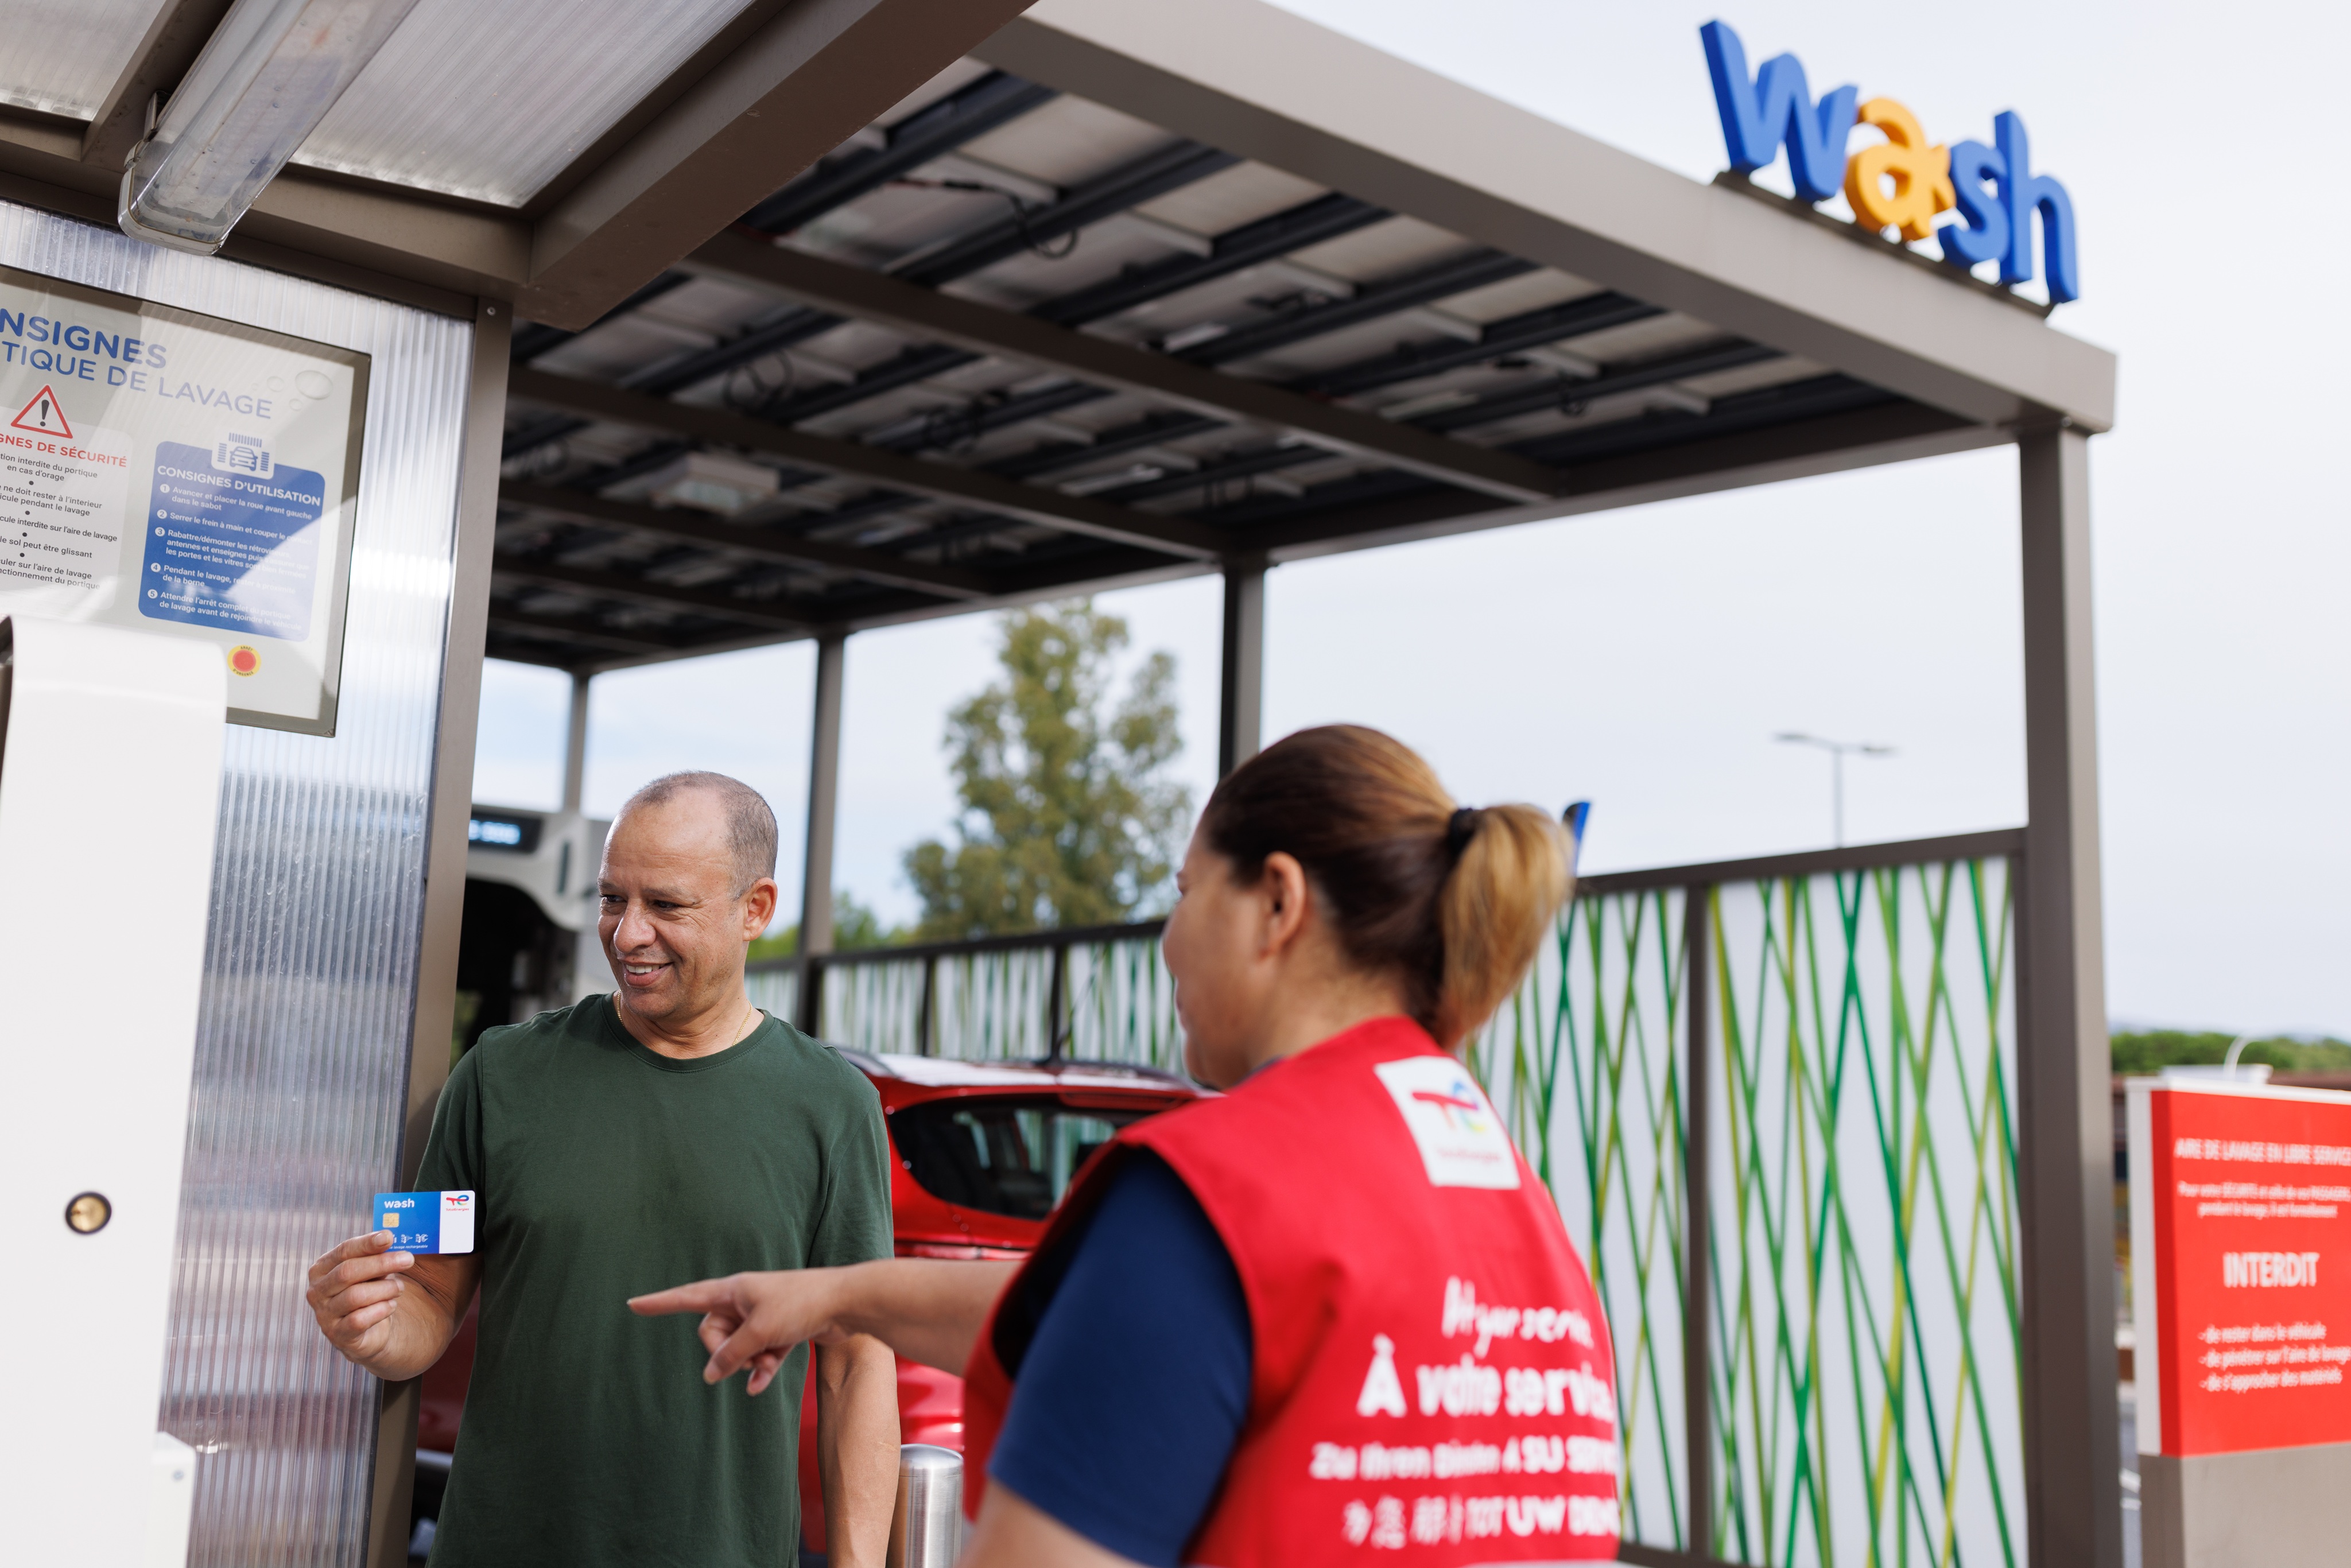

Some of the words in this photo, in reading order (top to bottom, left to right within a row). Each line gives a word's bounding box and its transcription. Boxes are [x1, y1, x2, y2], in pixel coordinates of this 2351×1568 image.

[1699, 18, 2079, 304] wash
[0, 308, 166, 368] NSIGNES
[2, 341, 96, 381] TIQUE
[107, 365, 148, 392] DE
[158, 377, 273, 419] LAVAGE
[0, 453, 15, 461] tion
[17, 456, 51, 469] interdite
[64, 467, 98, 478] portique
[37, 441, 56, 454] DE
[59, 445, 127, 468] SÉCURITÉ
[19, 467, 33, 475] cas
[35, 469, 64, 482] d'orage
[157, 465, 231, 488] CONSIGNES
[234, 480, 321, 506] D'UTILISATION
[15, 487, 31, 496] doit
[33, 491, 56, 501] rester
[65, 496, 103, 509] l'interieur
[20, 499, 53, 510] pendant
[55, 503, 63, 511] le
[64, 505, 90, 517] lavage
[172, 495, 191, 504] dans
[192, 499, 199, 507] le
[200, 501, 222, 511] sabot
[172, 487, 203, 498] Avancer
[214, 495, 238, 505] placer
[238, 498, 245, 507] la
[247, 501, 264, 510] roue
[265, 505, 285, 514] avant
[286, 509, 312, 520] gauche
[17, 518, 48, 530] interdite
[63, 526, 81, 535] l'aire
[93, 531, 118, 542] lavage
[170, 512, 193, 522] Serrer
[194, 516, 201, 524] le
[202, 518, 219, 527] frein
[226, 523, 244, 533] main
[253, 528, 278, 538] couper
[23, 541, 41, 550] peut
[43, 544, 59, 553] être
[61, 548, 92, 558] glissant
[166, 539, 201, 550] antennes
[211, 547, 247, 559] enseignes
[168, 529, 236, 548] Rabattre/démonter
[237, 542, 247, 550] les
[165, 547, 177, 556] les
[178, 550, 202, 560] portes
[212, 555, 223, 563] les
[224, 558, 243, 568] vitres
[245, 562, 260, 570] sont
[33, 563, 52, 573] l'aire
[54, 567, 64, 575] de
[66, 568, 92, 580] lavage
[162, 574, 172, 583] de
[183, 577, 205, 587] borne
[164, 565, 196, 577] Pendant
[197, 570, 204, 579] le
[55, 576, 65, 584] du
[67, 579, 100, 591] portique
[159, 600, 169, 609] de
[171, 601, 196, 614] lavage
[197, 608, 218, 616] avant
[219, 610, 230, 619] de
[231, 612, 262, 624] rejoindre
[160, 592, 194, 603] Attendre
[218, 601, 249, 613] complet
[261, 610, 291, 620] portique
[383, 1198, 415, 1209] wash
[2223, 1251, 2320, 1288] INTERDIT
